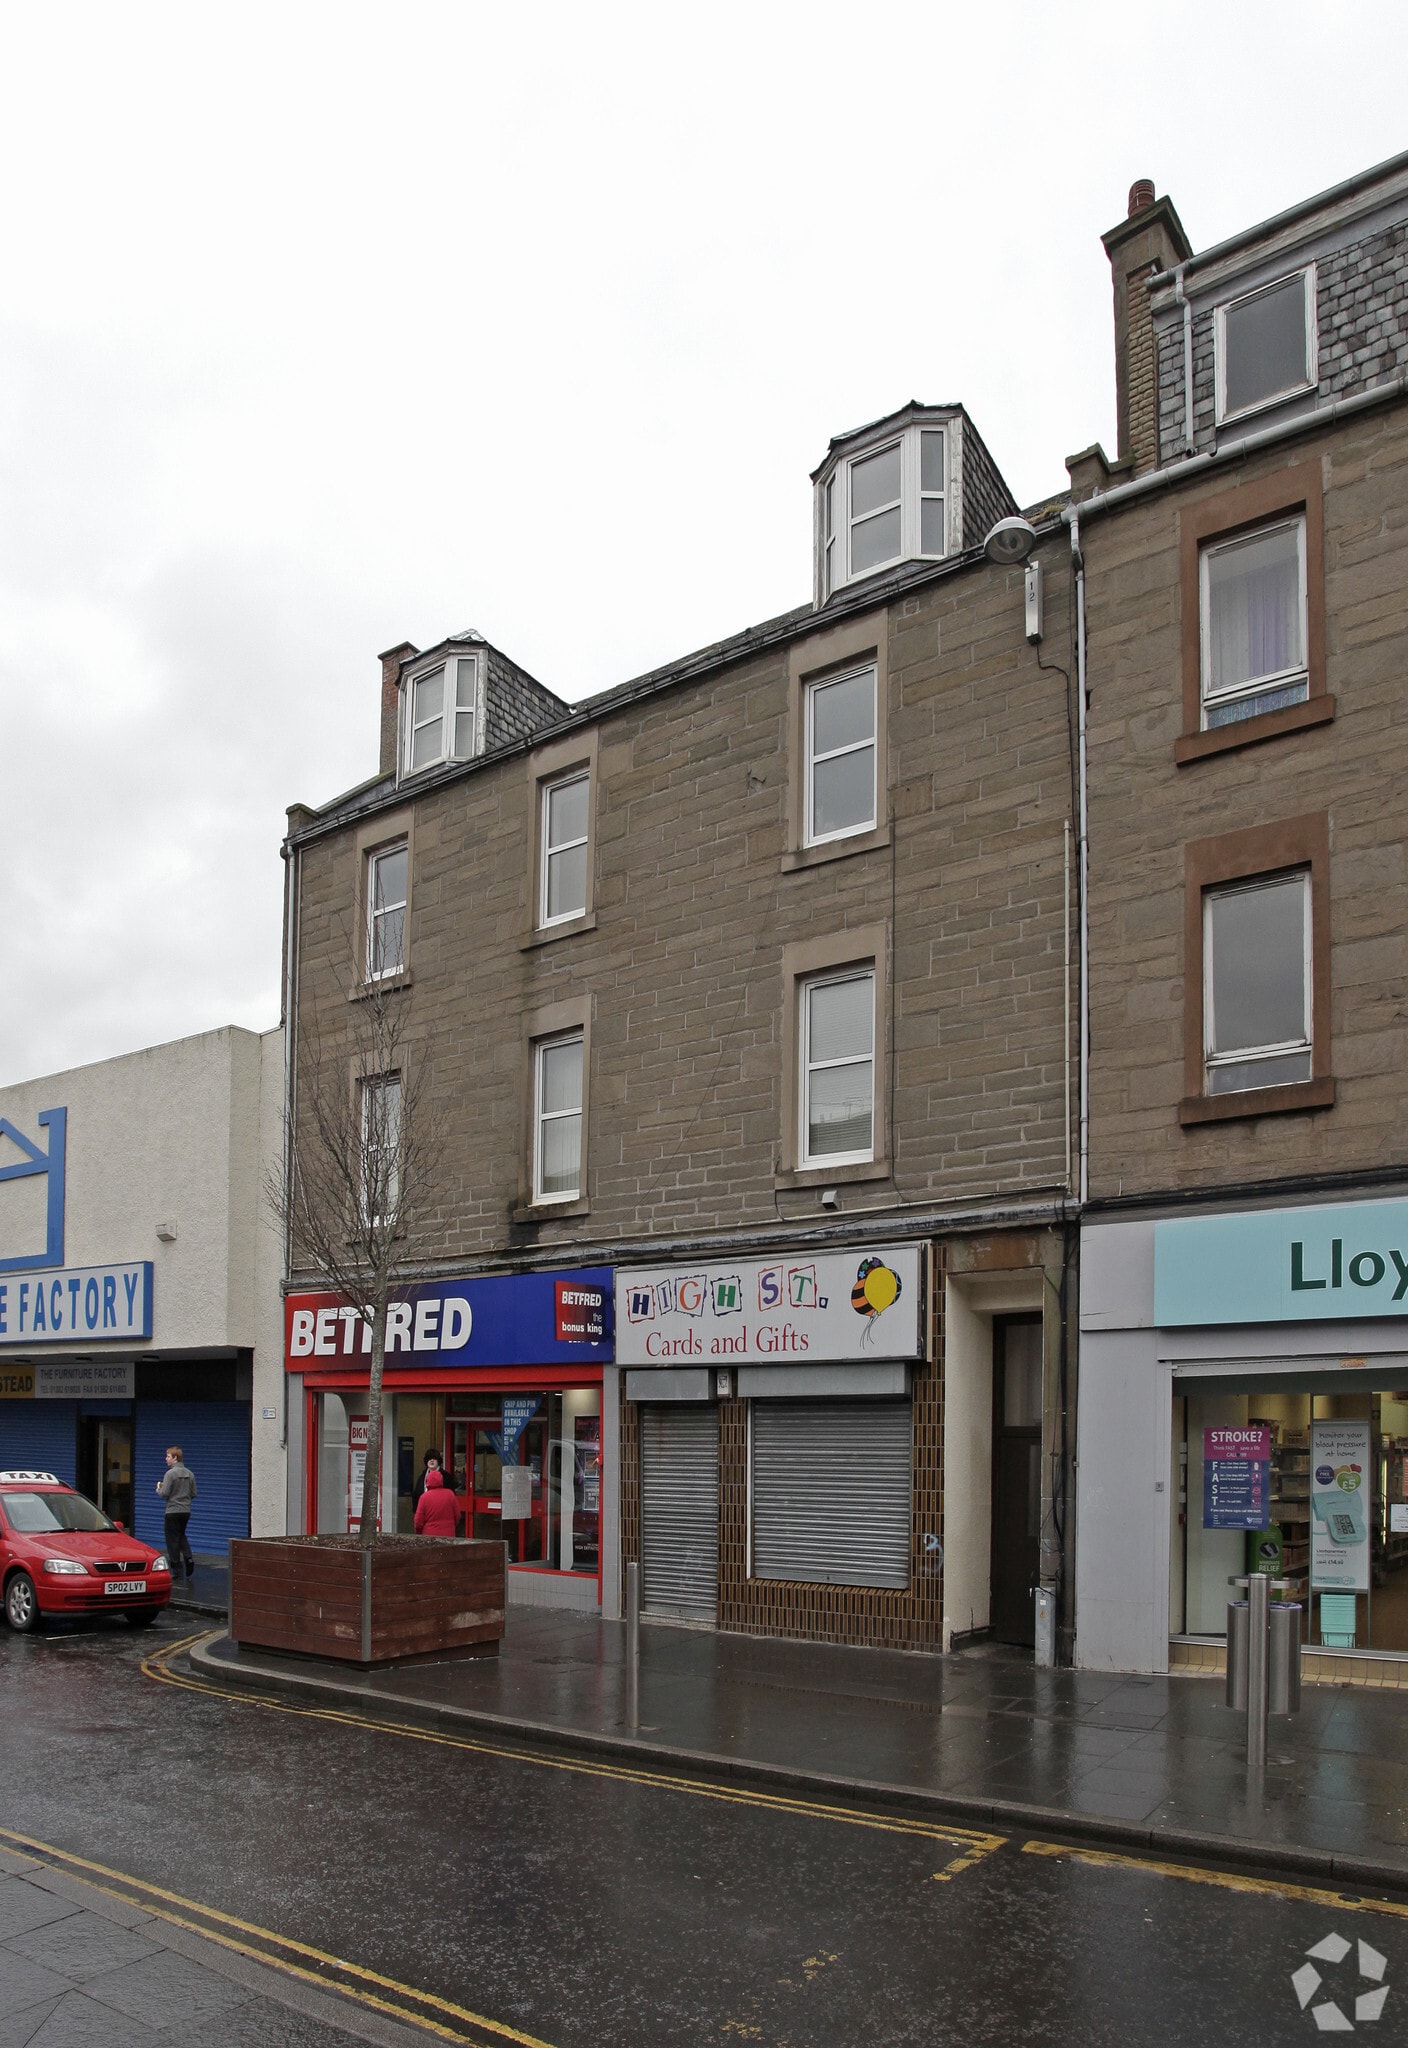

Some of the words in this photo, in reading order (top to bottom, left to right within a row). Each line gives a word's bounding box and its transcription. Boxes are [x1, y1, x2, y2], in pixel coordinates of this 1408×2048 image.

[19, 1272, 139, 1333] FACTORY
[561, 1291, 602, 1307] BETFRED
[631, 1279, 738, 1317] HIGH
[592, 1312, 603, 1323] the
[561, 1321, 585, 1332] bonus
[587, 1322, 603, 1335] king
[645, 1328, 703, 1357] Cards
[710, 1325, 748, 1355] and
[755, 1322, 810, 1353] Gifts
[40, 1368, 53, 1380] THE
[54, 1368, 93, 1380] FURNITURE
[94, 1367, 127, 1379] FACTORY
[504, 1400, 516, 1408] CHIP
[516, 1400, 526, 1408] AND
[527, 1400, 536, 1408] PIN
[504, 1409, 530, 1417] AVAILABLE
[352, 1427, 363, 1439] BIG
[504, 1427, 517, 1435] SHOP
[1211, 1431, 1263, 1443] STROKE?
[1346, 1433, 1363, 1441] your
[1315, 1441, 1334, 1449] blood
[1212, 1461, 1218, 1471] F
[5, 1472, 54, 1481] TAXI
[1212, 1473, 1219, 1482] A
[1212, 1484, 1218, 1494] S
[1212, 1496, 1218, 1506] T
[129, 1582, 144, 1592] LVY
